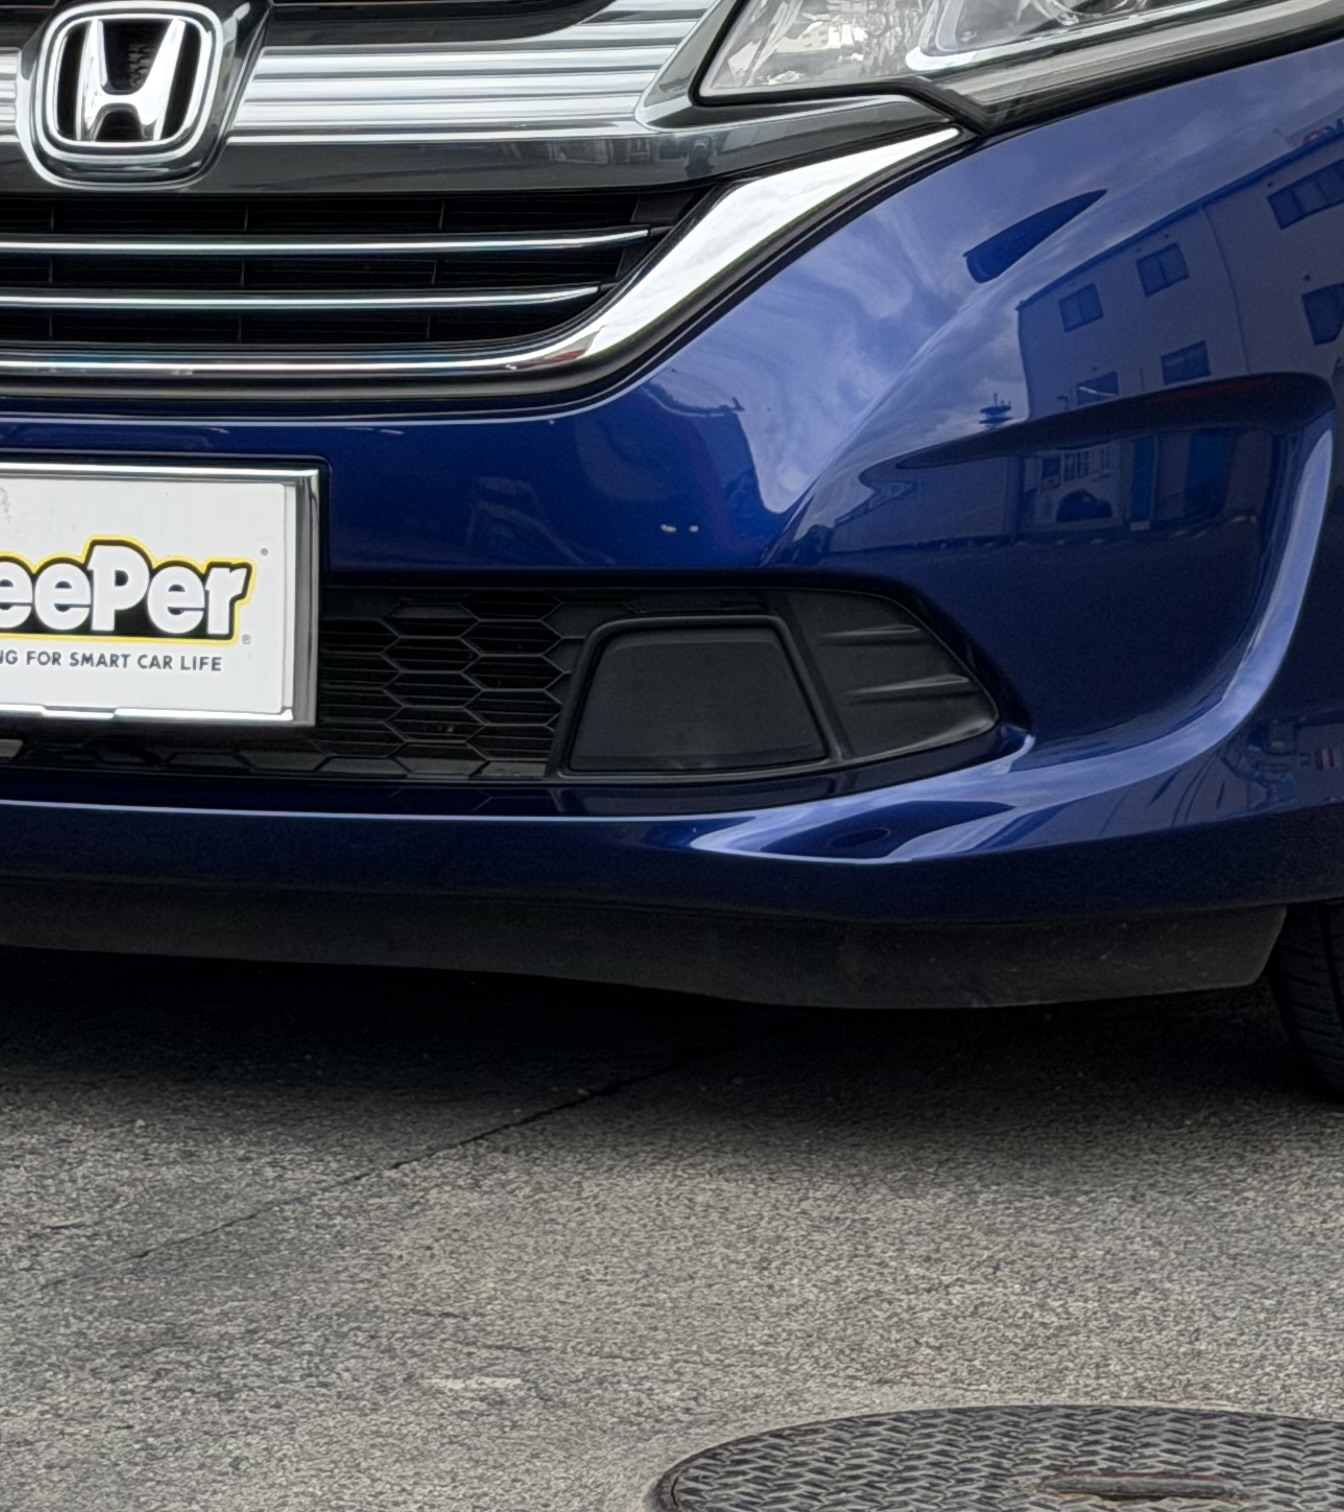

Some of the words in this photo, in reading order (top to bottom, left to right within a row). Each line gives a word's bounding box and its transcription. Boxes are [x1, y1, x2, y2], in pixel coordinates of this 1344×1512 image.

[26, 650, 62, 667] FOR
[69, 651, 131, 669] SMART
[137, 653, 173, 671] CAR
[180, 655, 223, 672] LIFE
